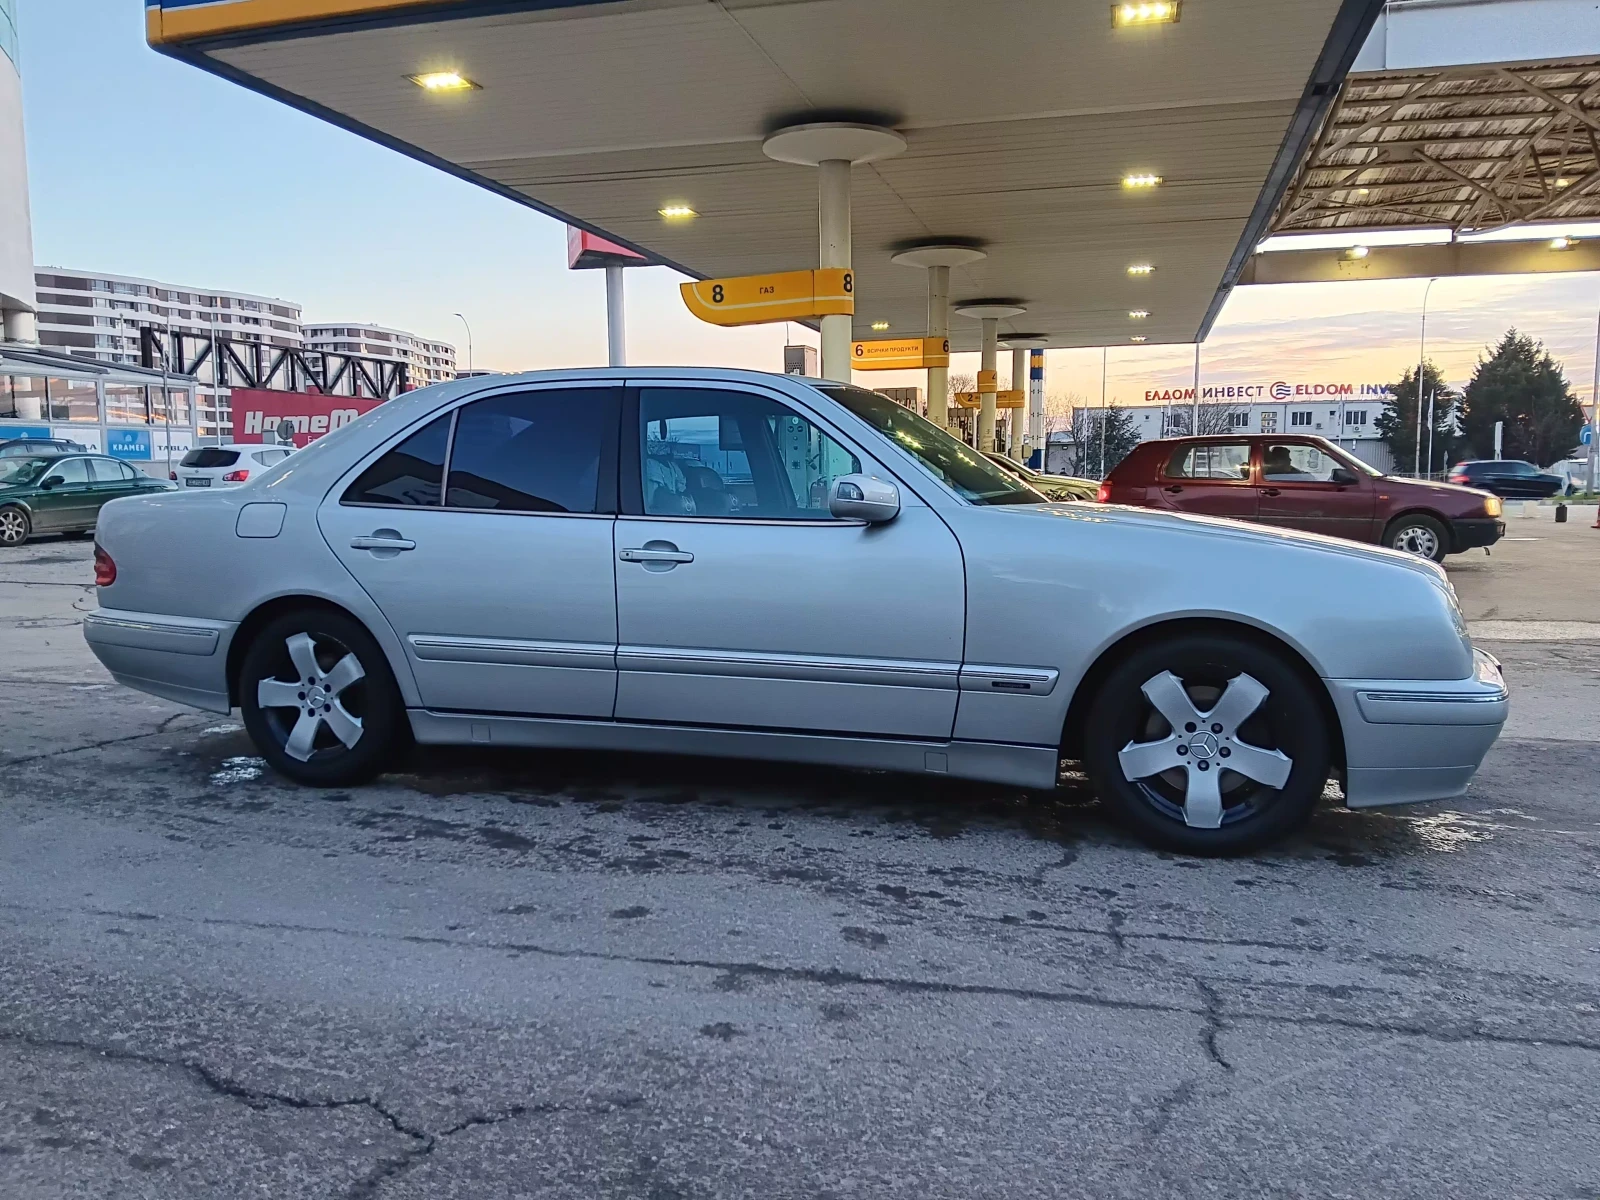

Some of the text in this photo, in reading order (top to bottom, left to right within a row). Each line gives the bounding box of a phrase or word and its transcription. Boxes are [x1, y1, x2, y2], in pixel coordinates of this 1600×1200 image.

[843, 273, 853, 293] 8
[712, 284, 725, 303] 8
[759, 286, 775, 295] ГАЗ
[855, 344, 864, 357] 6
[943, 340, 949, 353] 6
[1203, 386, 1264, 398] ИНВЕСТ
[1295, 383, 1395, 395] ELDOM INV
[967, 394, 973, 402] 2
[112, 443, 146, 452] KRAMER
